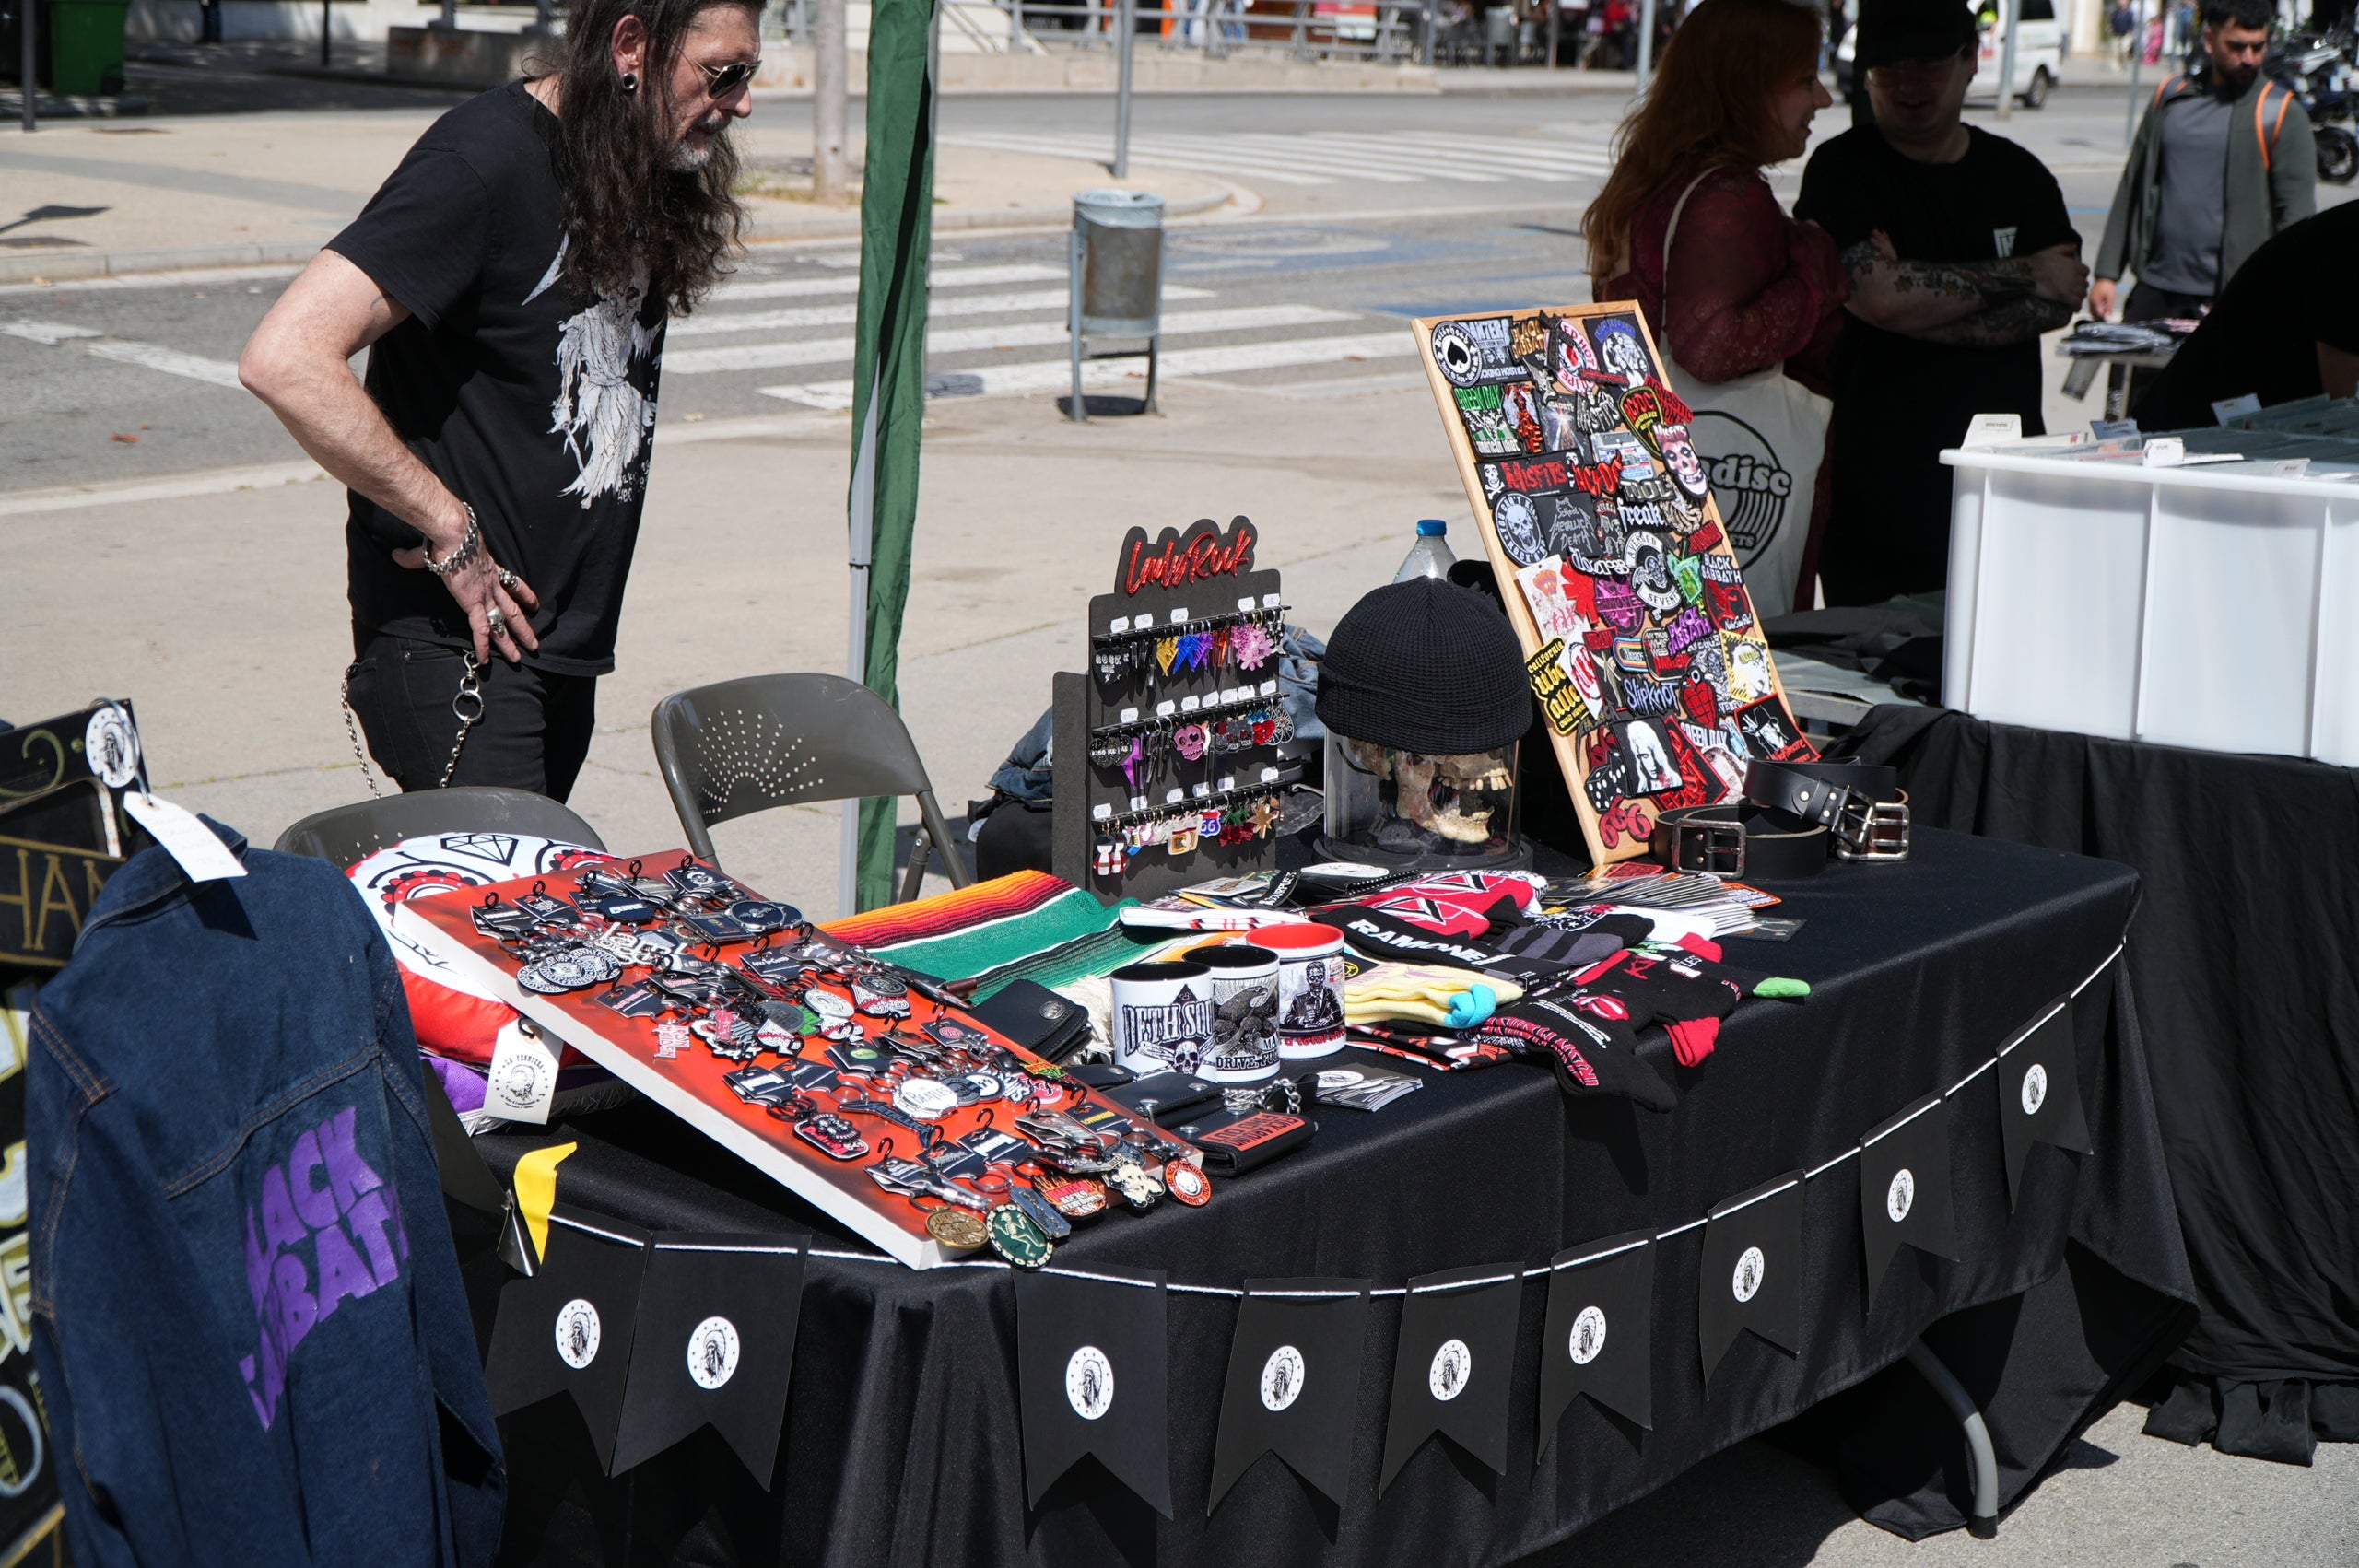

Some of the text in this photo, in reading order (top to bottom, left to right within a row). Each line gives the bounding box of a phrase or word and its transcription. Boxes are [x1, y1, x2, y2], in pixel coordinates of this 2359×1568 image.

[1708, 456, 1791, 497] disc
[1533, 662, 1567, 695] übe
[1550, 685, 1580, 719] alle
[1347, 919, 1491, 965] RAMONE
[1182, 999, 1214, 1036] SQU
